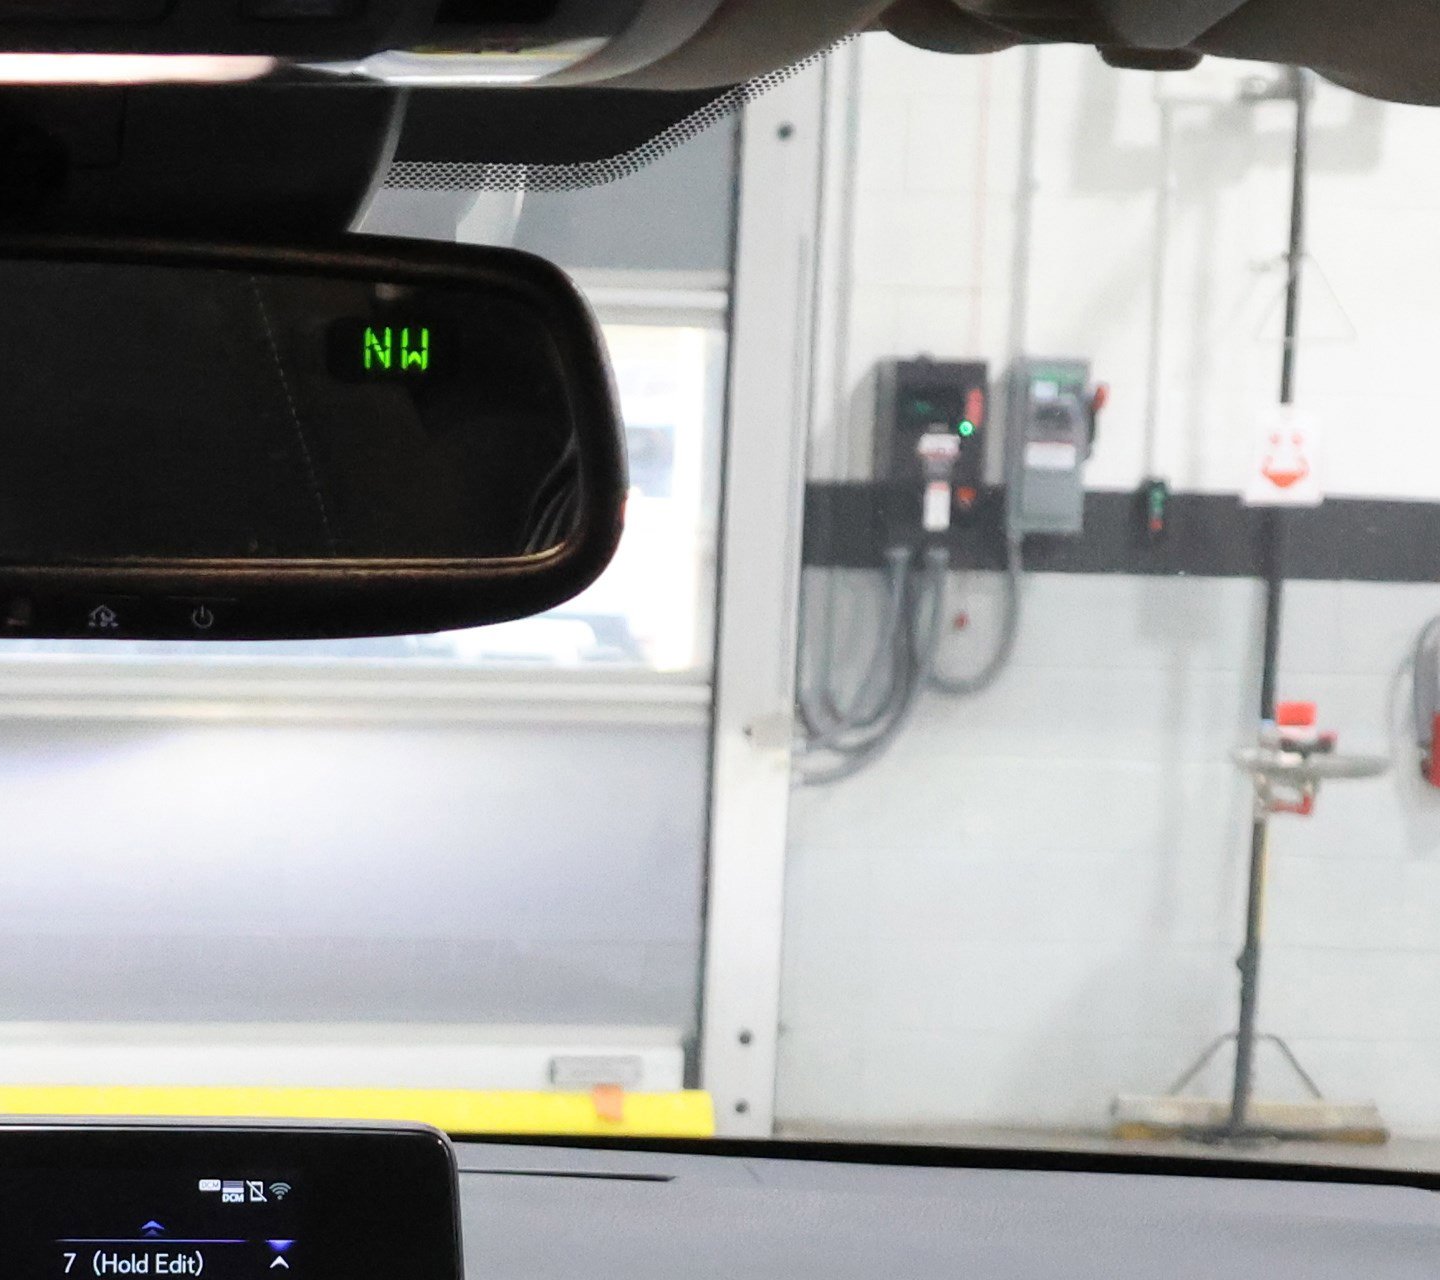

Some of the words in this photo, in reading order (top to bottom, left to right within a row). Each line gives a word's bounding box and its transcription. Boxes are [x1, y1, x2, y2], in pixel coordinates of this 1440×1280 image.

[365, 327, 428, 369] NW
[62, 1253, 77, 1274] 7
[93, 1250, 147, 1278] (Hold
[154, 1250, 204, 1278] Edit)
